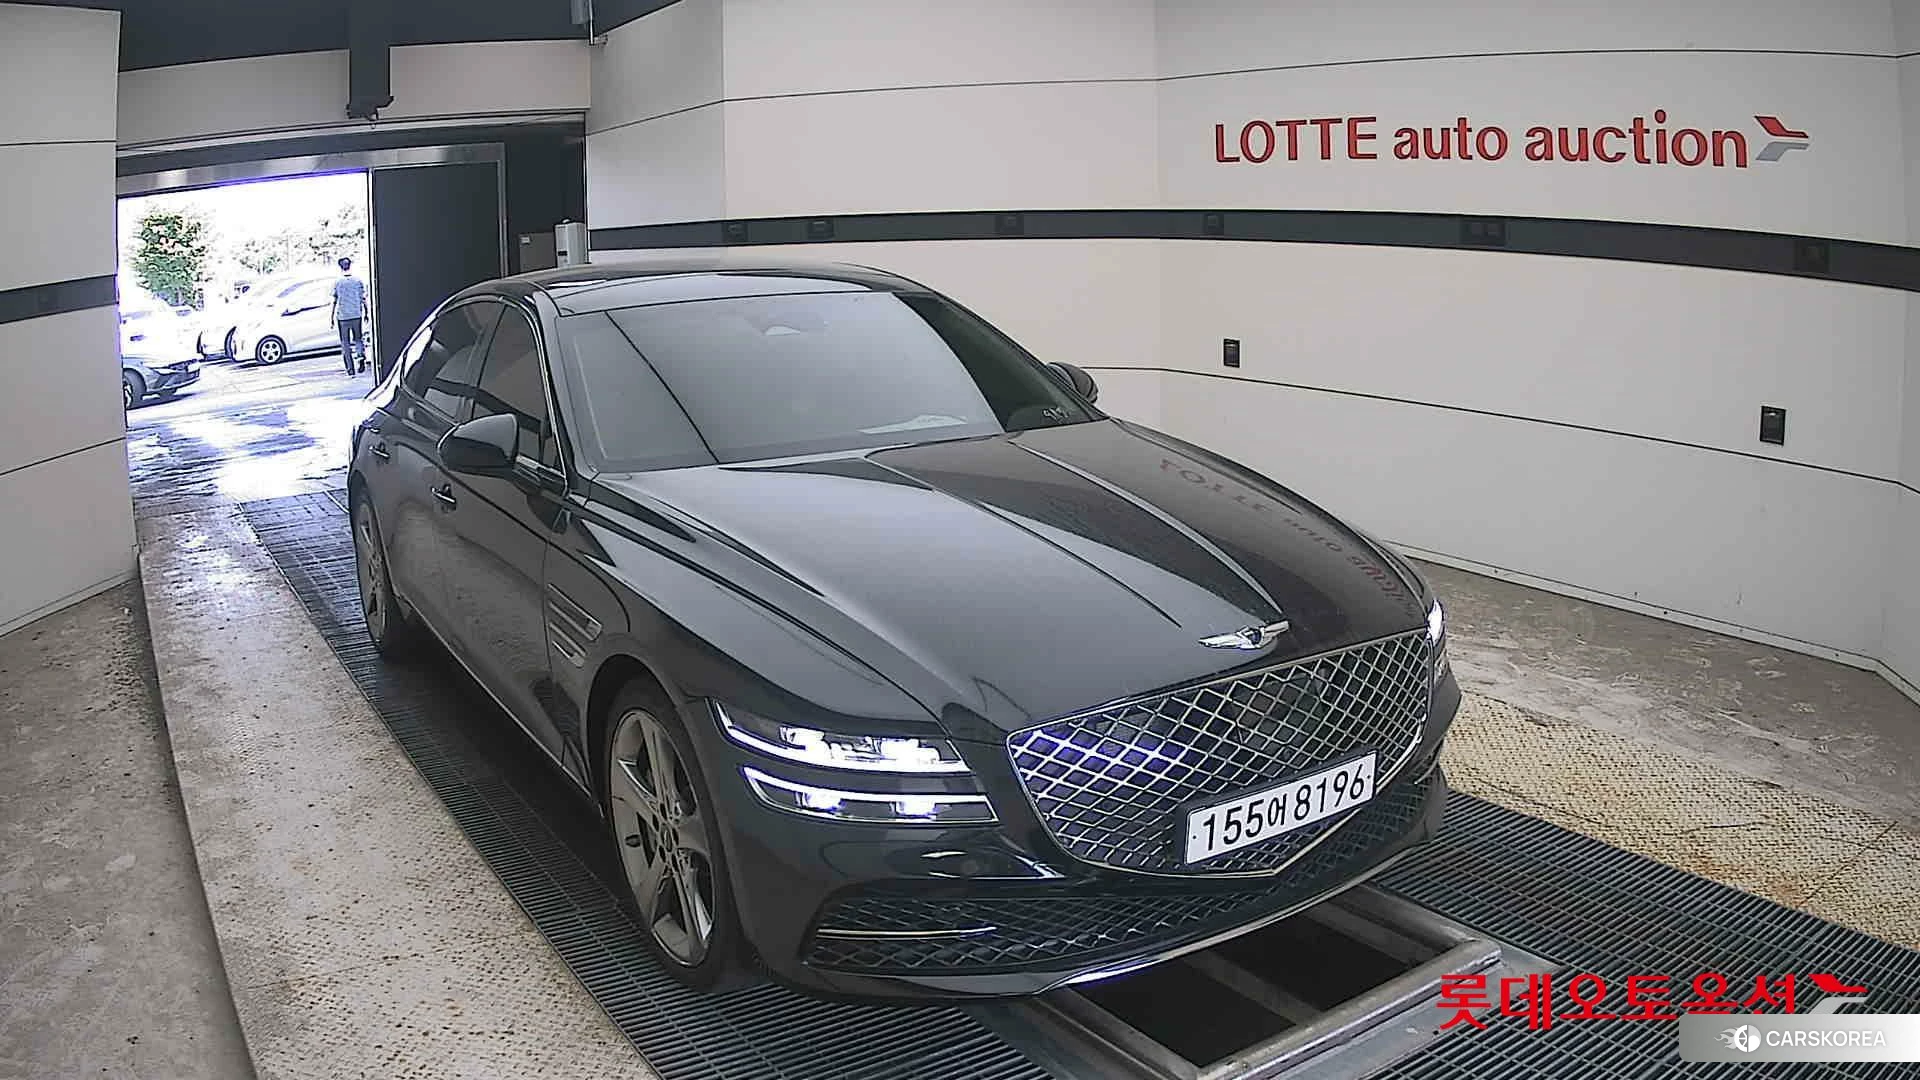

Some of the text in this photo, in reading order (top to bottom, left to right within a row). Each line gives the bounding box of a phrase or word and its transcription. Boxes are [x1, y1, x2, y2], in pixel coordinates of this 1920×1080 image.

[1215, 110, 1748, 168] LOTTE auto auction
[1293, 763, 1365, 821] 8196
